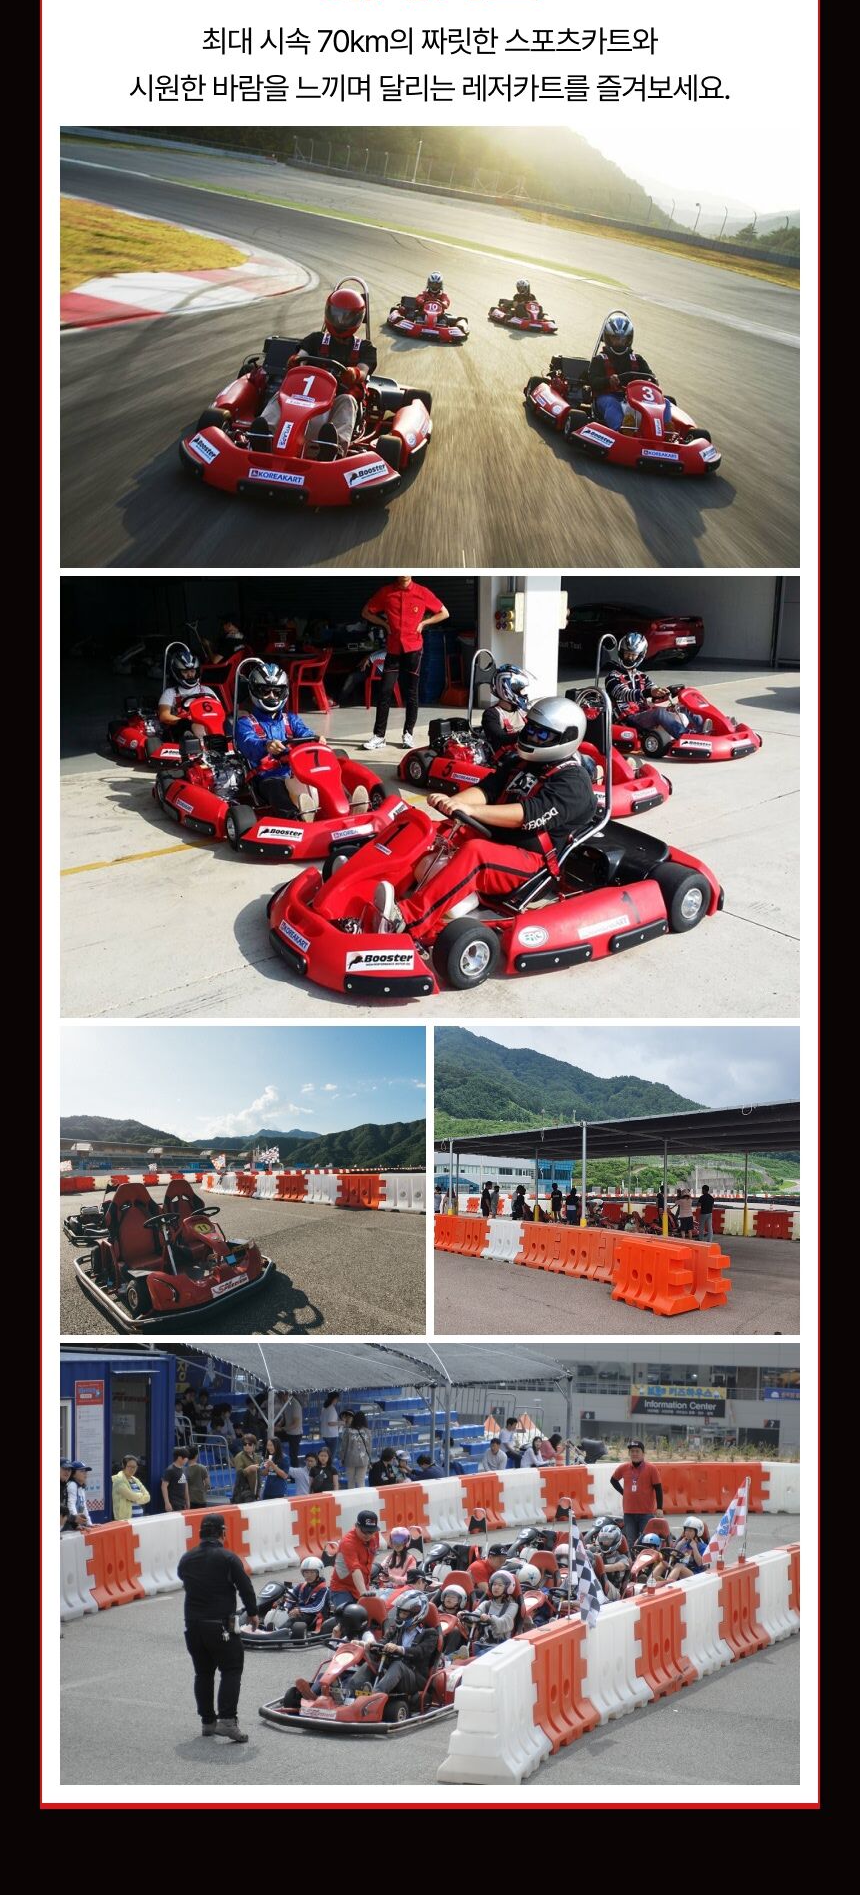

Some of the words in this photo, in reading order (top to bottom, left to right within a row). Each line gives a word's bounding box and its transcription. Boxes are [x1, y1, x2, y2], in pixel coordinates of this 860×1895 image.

[303, 375, 315, 396] 1
[642, 386, 655, 401] 3
[358, 464, 386, 478] Booster
[258, 471, 302, 484] KOREAKART
[202, 701, 213, 712] 6
[305, 750, 322, 767] 7
[269, 828, 302, 837] Booster
[282, 923, 309, 949] KOREAKART
[364, 953, 413, 963] Booster
[644, 1400, 687, 1409] Information
[690, 1402, 717, 1411] Center
[430, 1544, 443, 1554] 2
[262, 1584, 276, 1595] 9
